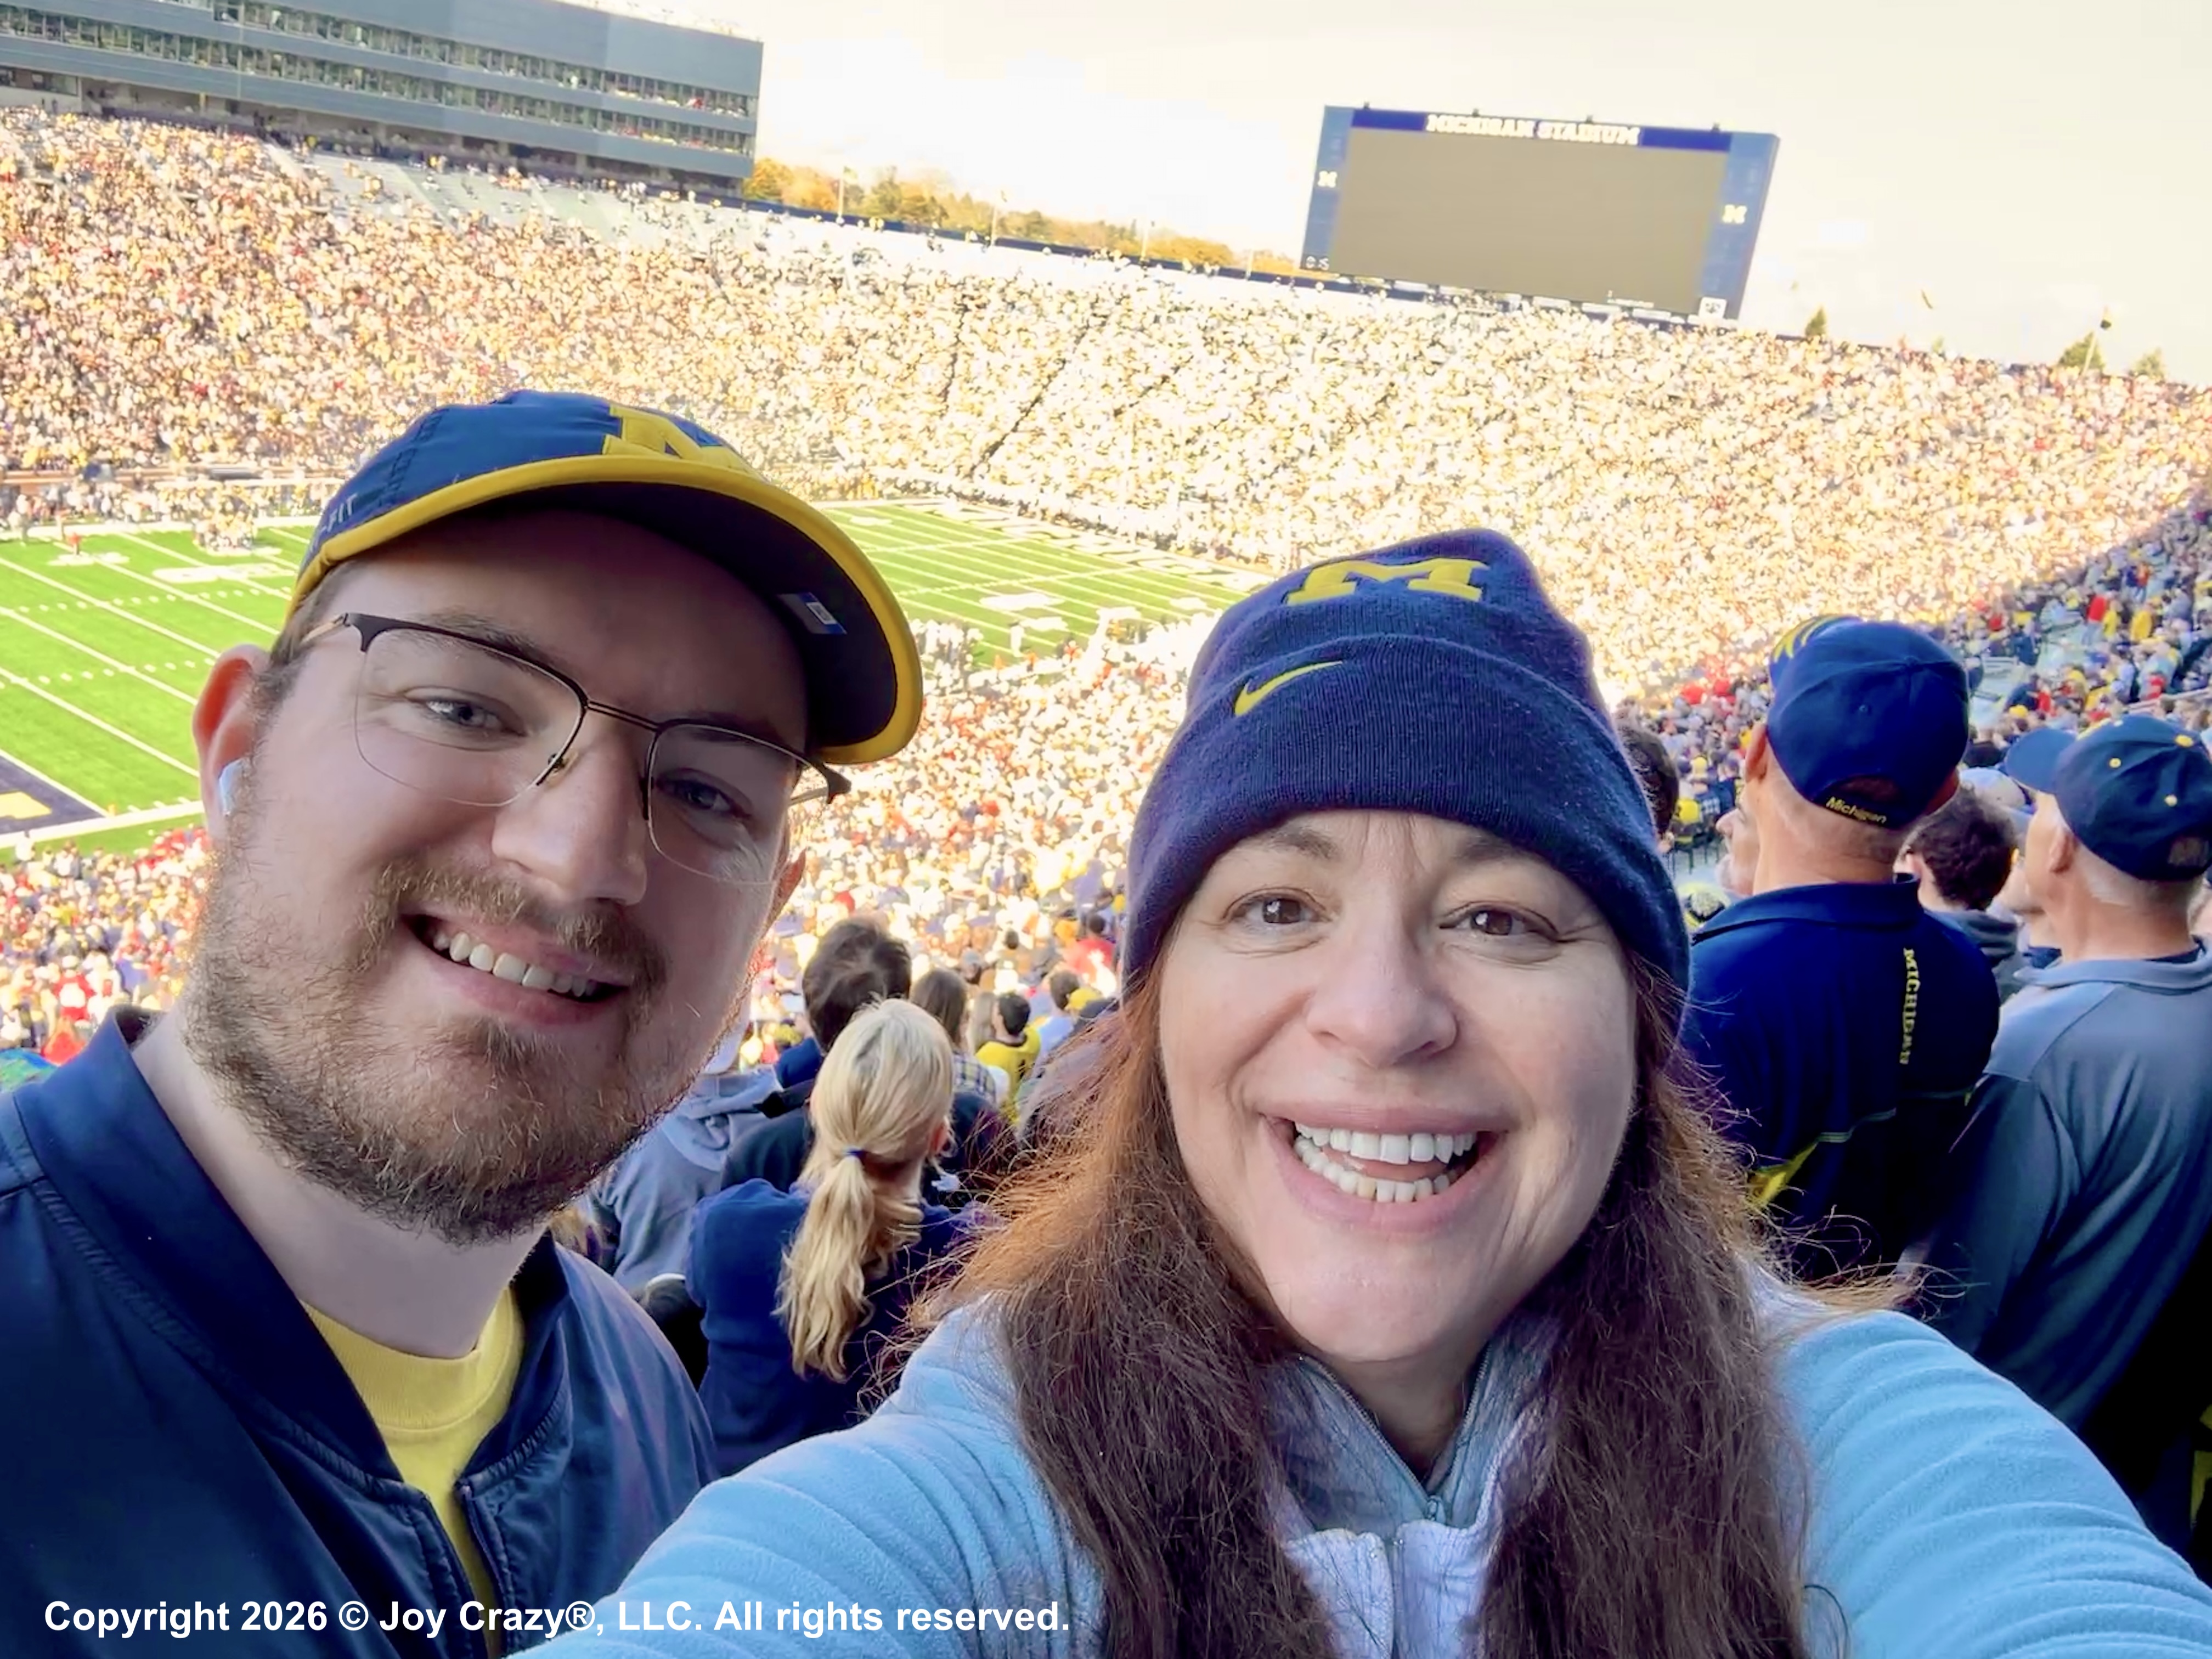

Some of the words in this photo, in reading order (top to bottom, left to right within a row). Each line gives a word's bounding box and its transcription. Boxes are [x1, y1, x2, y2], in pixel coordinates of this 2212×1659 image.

[1426, 114, 1536, 138] MICHIGAN
[1537, 120, 1641, 145] STADIUM
[602, 404, 765, 476] M
[1285, 557, 1491, 606] M
